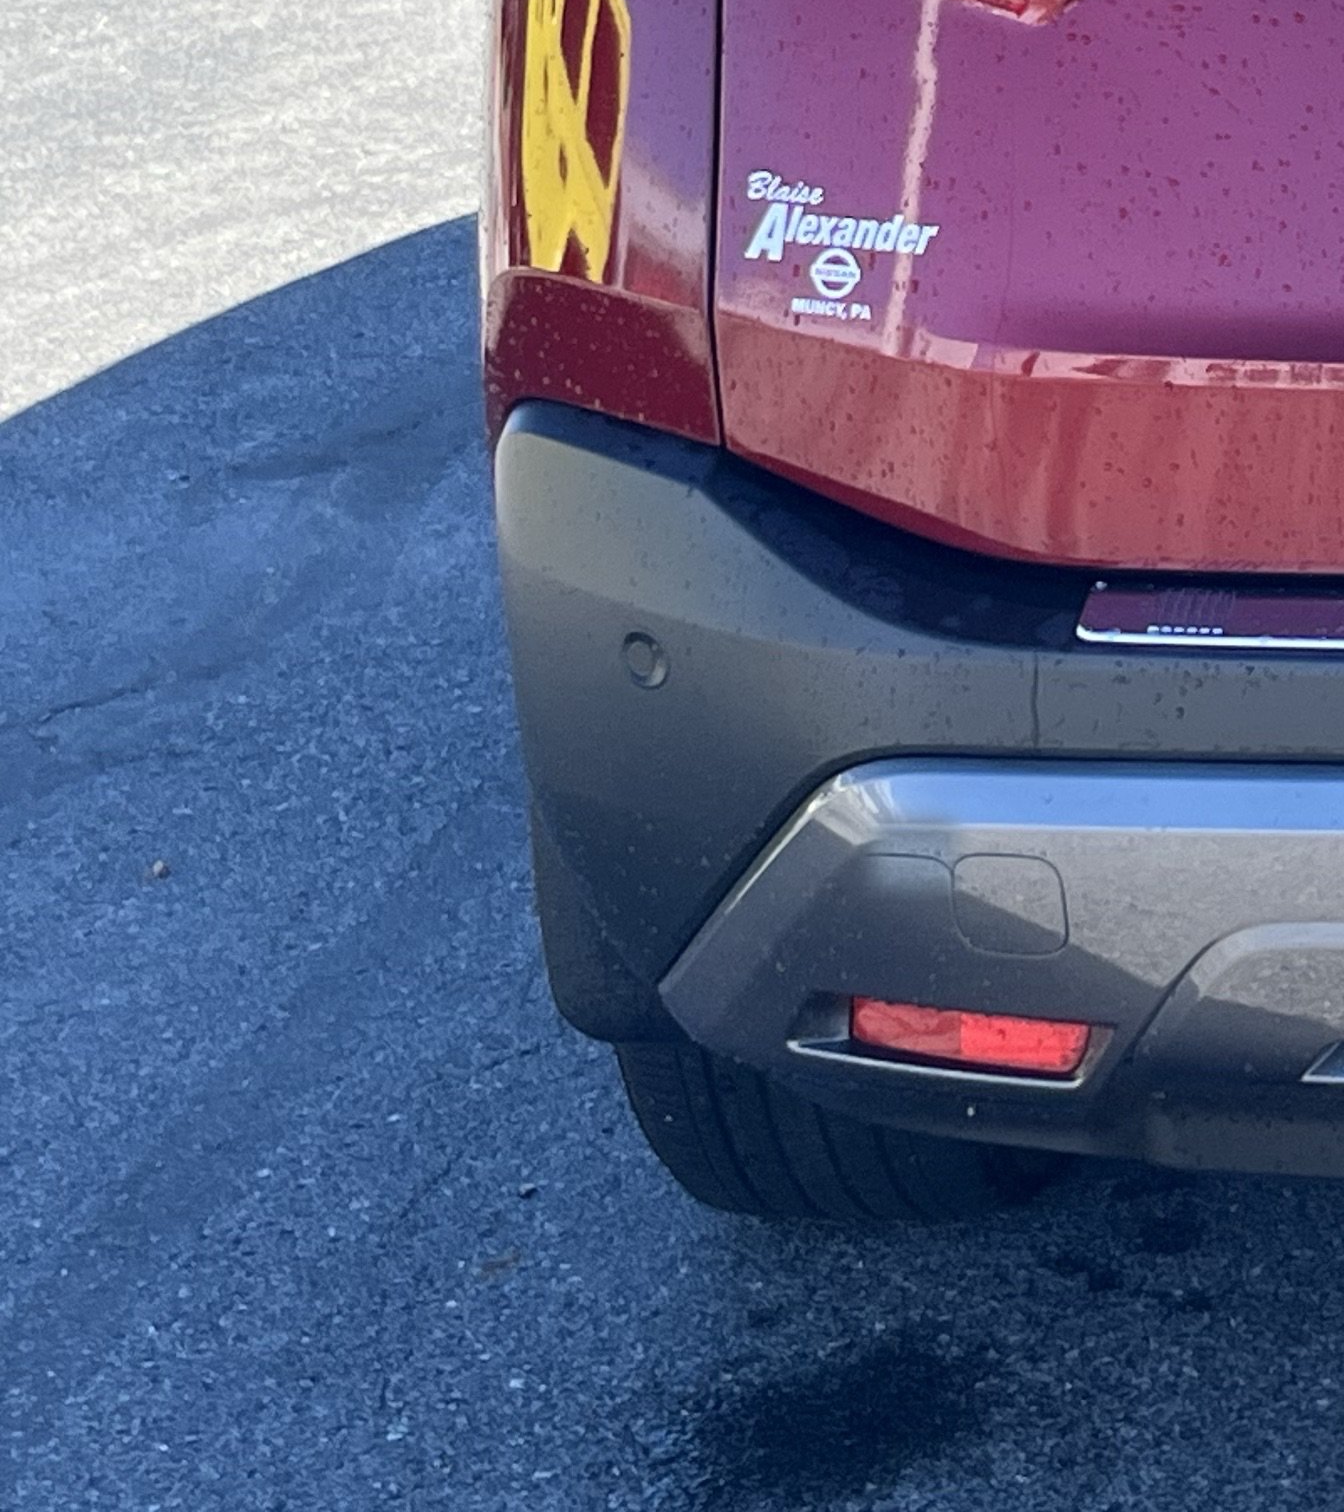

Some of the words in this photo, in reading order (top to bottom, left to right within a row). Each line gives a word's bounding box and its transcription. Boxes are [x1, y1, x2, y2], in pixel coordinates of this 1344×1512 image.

[747, 170, 824, 205] Blaise
[744, 202, 940, 262] Alexander
[791, 297, 847, 320] MUNCY,
[850, 303, 872, 320] PA
